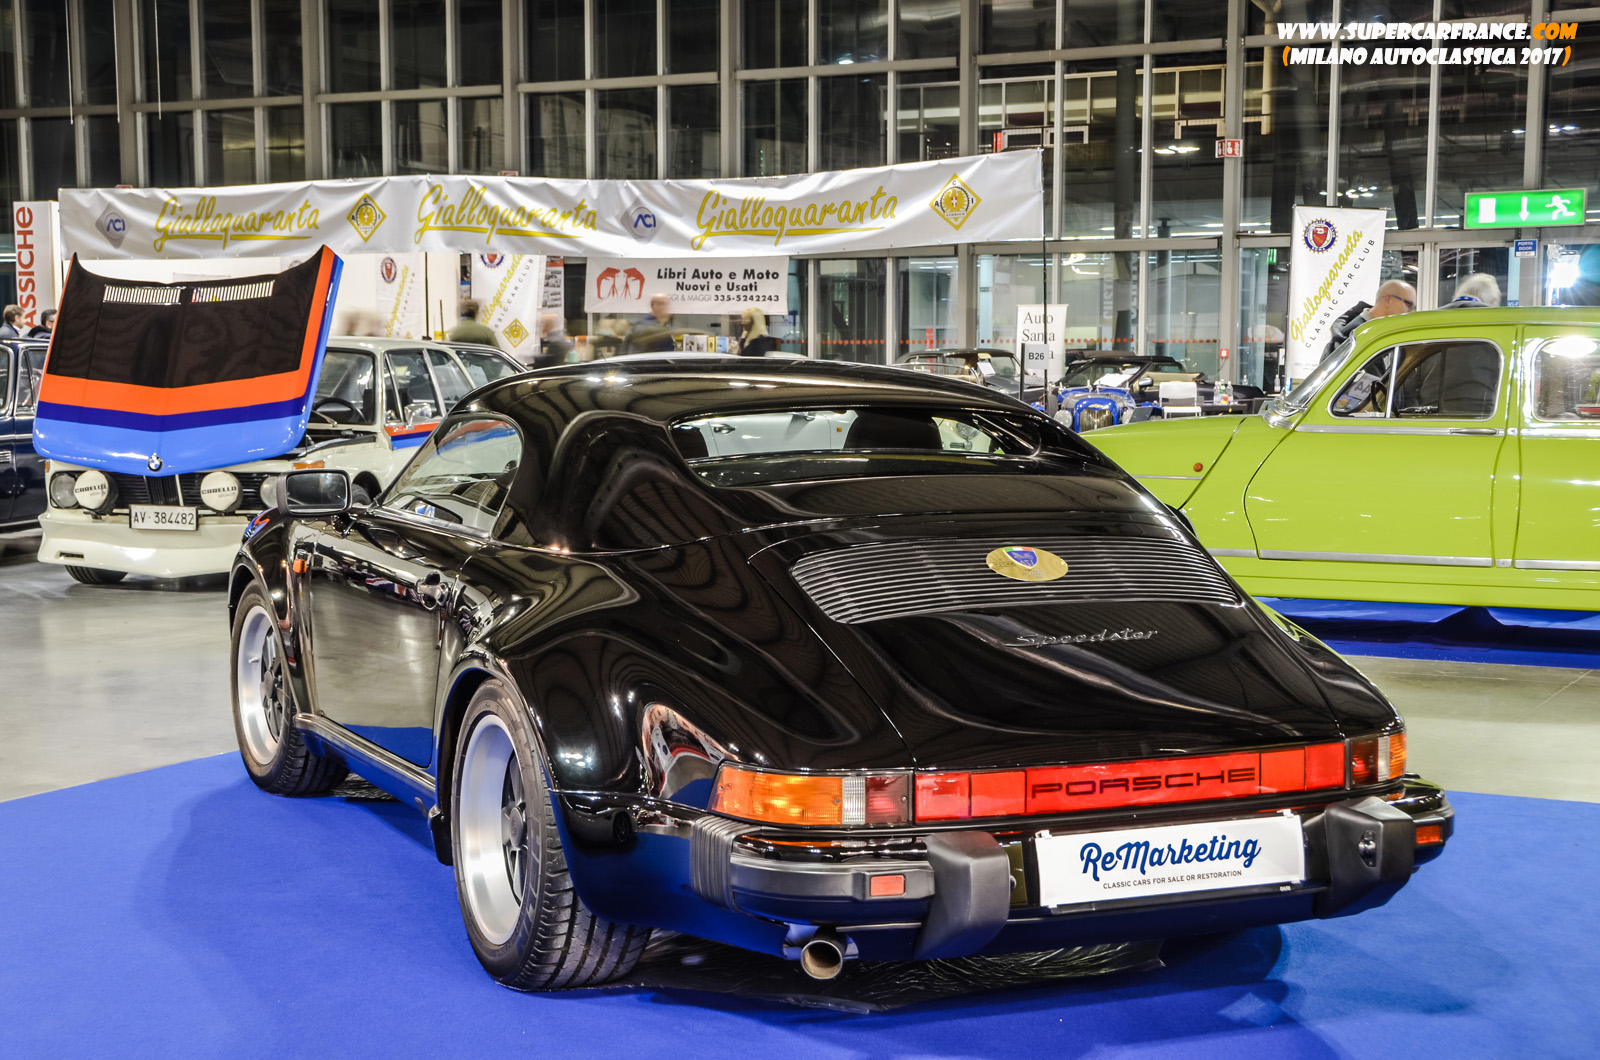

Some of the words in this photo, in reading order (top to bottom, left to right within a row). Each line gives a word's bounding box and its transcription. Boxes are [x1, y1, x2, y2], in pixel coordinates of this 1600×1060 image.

[153, 196, 319, 252] Gialloquaranta
[414, 184, 597, 244] Gialloquaranta
[633, 213, 657, 228] ACI
[691, 186, 897, 250] Gialloquaranta
[106, 218, 126, 232] ACI
[656, 268, 686, 280] Libri
[691, 268, 723, 280] Auto
[728, 271, 737, 280] e
[743, 268, 780, 280] Moto
[676, 281, 710, 292] Nuovi
[714, 283, 722, 292] e
[726, 281, 758, 292] Usati
[1290, 230, 1362, 343] Gialloquaranta
[1305, 299, 1338, 349] CLASSIC
[1338, 273, 1355, 296] CAR
[1354, 239, 1375, 270] CLUB
[687, 294, 712, 302] MAGGI
[713, 294, 780, 302] 335-5242243
[1023, 311, 1054, 324] Auo
[1022, 328, 1055, 342] Sana
[1028, 352, 1045, 360] B26
[1005, 628, 1158, 649] Speedster
[1031, 767, 1256, 799] PORSCHE
[1080, 834, 1262, 881] ReMarketing
[1102, 880, 1132, 890] CLASSIC
[1132, 879, 1151, 887] CARS
[1167, 875, 1185, 883] SALE
[1196, 870, 1243, 880] RESTORATION
